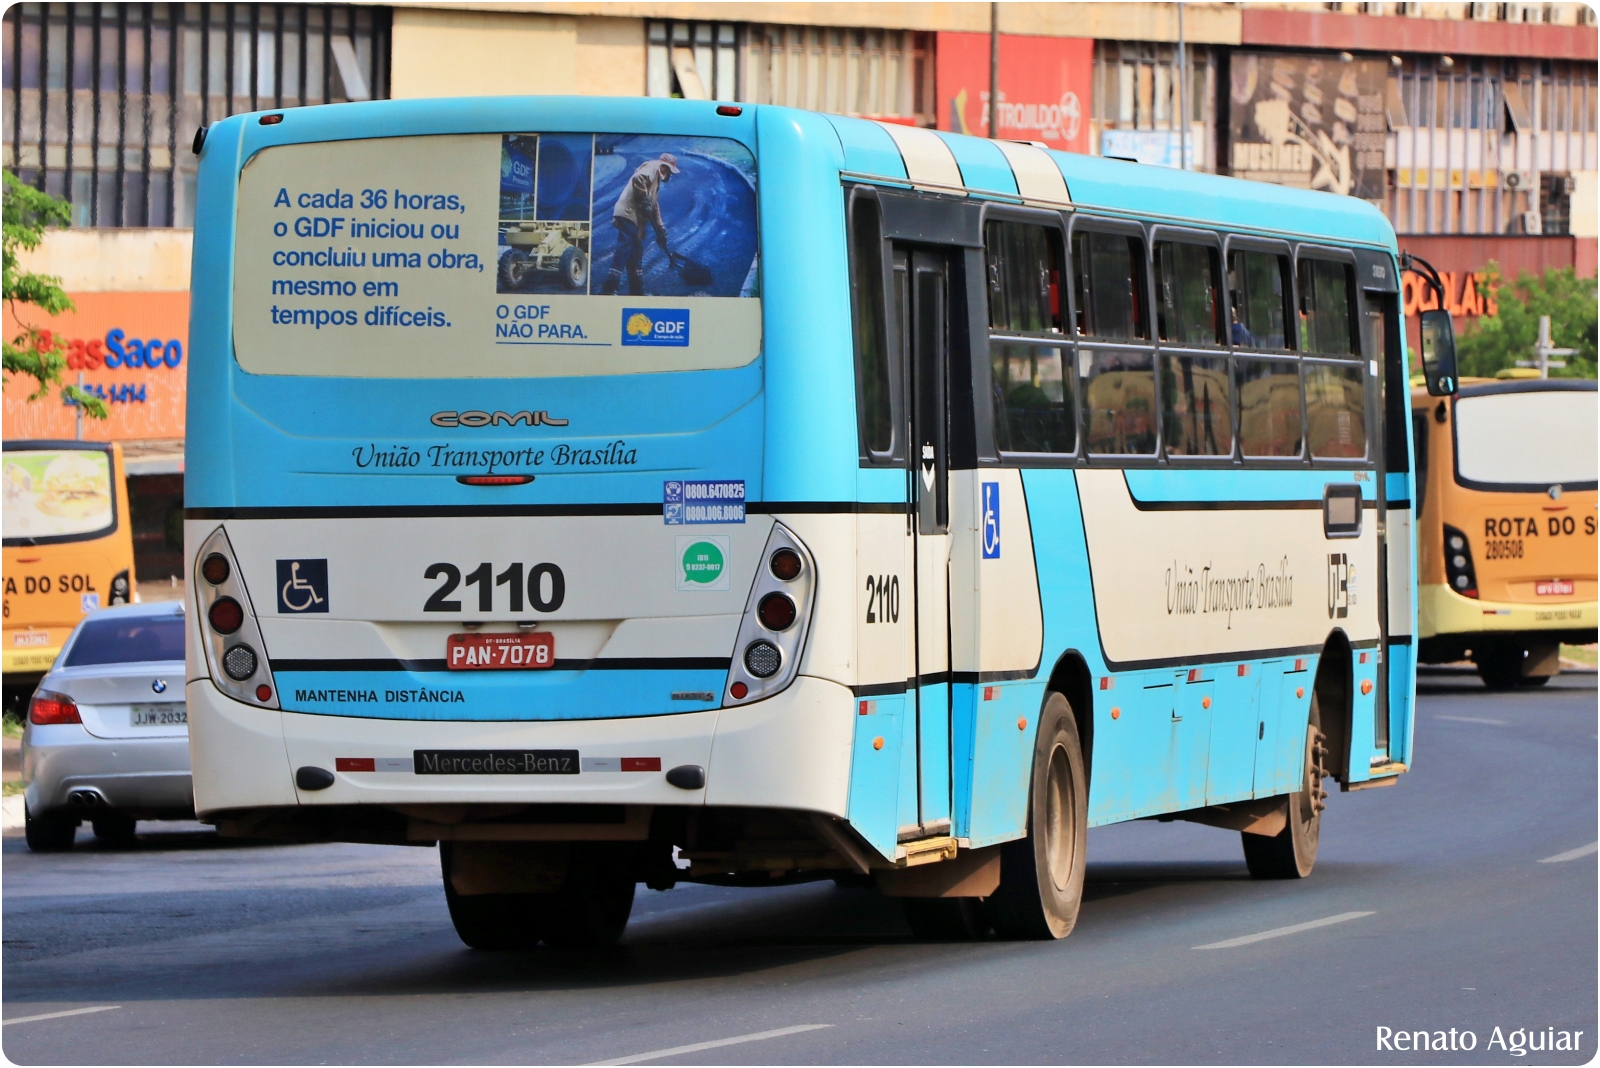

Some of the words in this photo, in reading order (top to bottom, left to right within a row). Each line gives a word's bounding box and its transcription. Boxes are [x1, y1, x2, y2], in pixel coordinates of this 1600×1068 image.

[513, 160, 530, 177] GDF
[273, 187, 291, 207] A
[297, 189, 354, 209] cada
[360, 189, 388, 209] 36
[394, 189, 465, 214] horas,
[273, 221, 288, 237] o
[294, 217, 345, 238] GDF
[351, 218, 424, 239] iniciou
[430, 224, 459, 239] ou
[272, 247, 365, 267] concluiu
[372, 252, 421, 268] uma
[427, 248, 484, 272] obra,
[272, 280, 357, 296] mesmo
[363, 281, 399, 297] em
[270, 305, 358, 329] tempos
[364, 305, 451, 327] difíceis.
[496, 304, 509, 319] O
[514, 305, 550, 319] GDF
[496, 320, 533, 338] NÃO
[538, 324, 588, 339] PARA.
[654, 321, 685, 333] GDF
[430, 410, 569, 427] COMIL
[352, 444, 420, 468] União
[427, 443, 544, 474] Transporte
[550, 440, 638, 466] Brasília
[685, 483, 745, 499] 0800.6470825
[685, 505, 744, 521] 0800.006.8006
[1485, 517, 1539, 537] ROTA
[1548, 516, 1576, 536] DO
[1584, 516, 1598, 535] S
[1486, 539, 1524, 560] 280508
[25, 576, 51, 594] DO
[58, 574, 96, 593] SOL
[423, 562, 566, 613] 2110
[1165, 559, 1198, 615] União
[1201, 560, 1255, 630] Transporte
[1257, 554, 1293, 609] Brasília
[866, 574, 899, 624] 2110
[295, 689, 378, 702] MANTENHA
[385, 687, 465, 703] DISTÂNCIA
[423, 753, 571, 772] Mercedes-Benz
